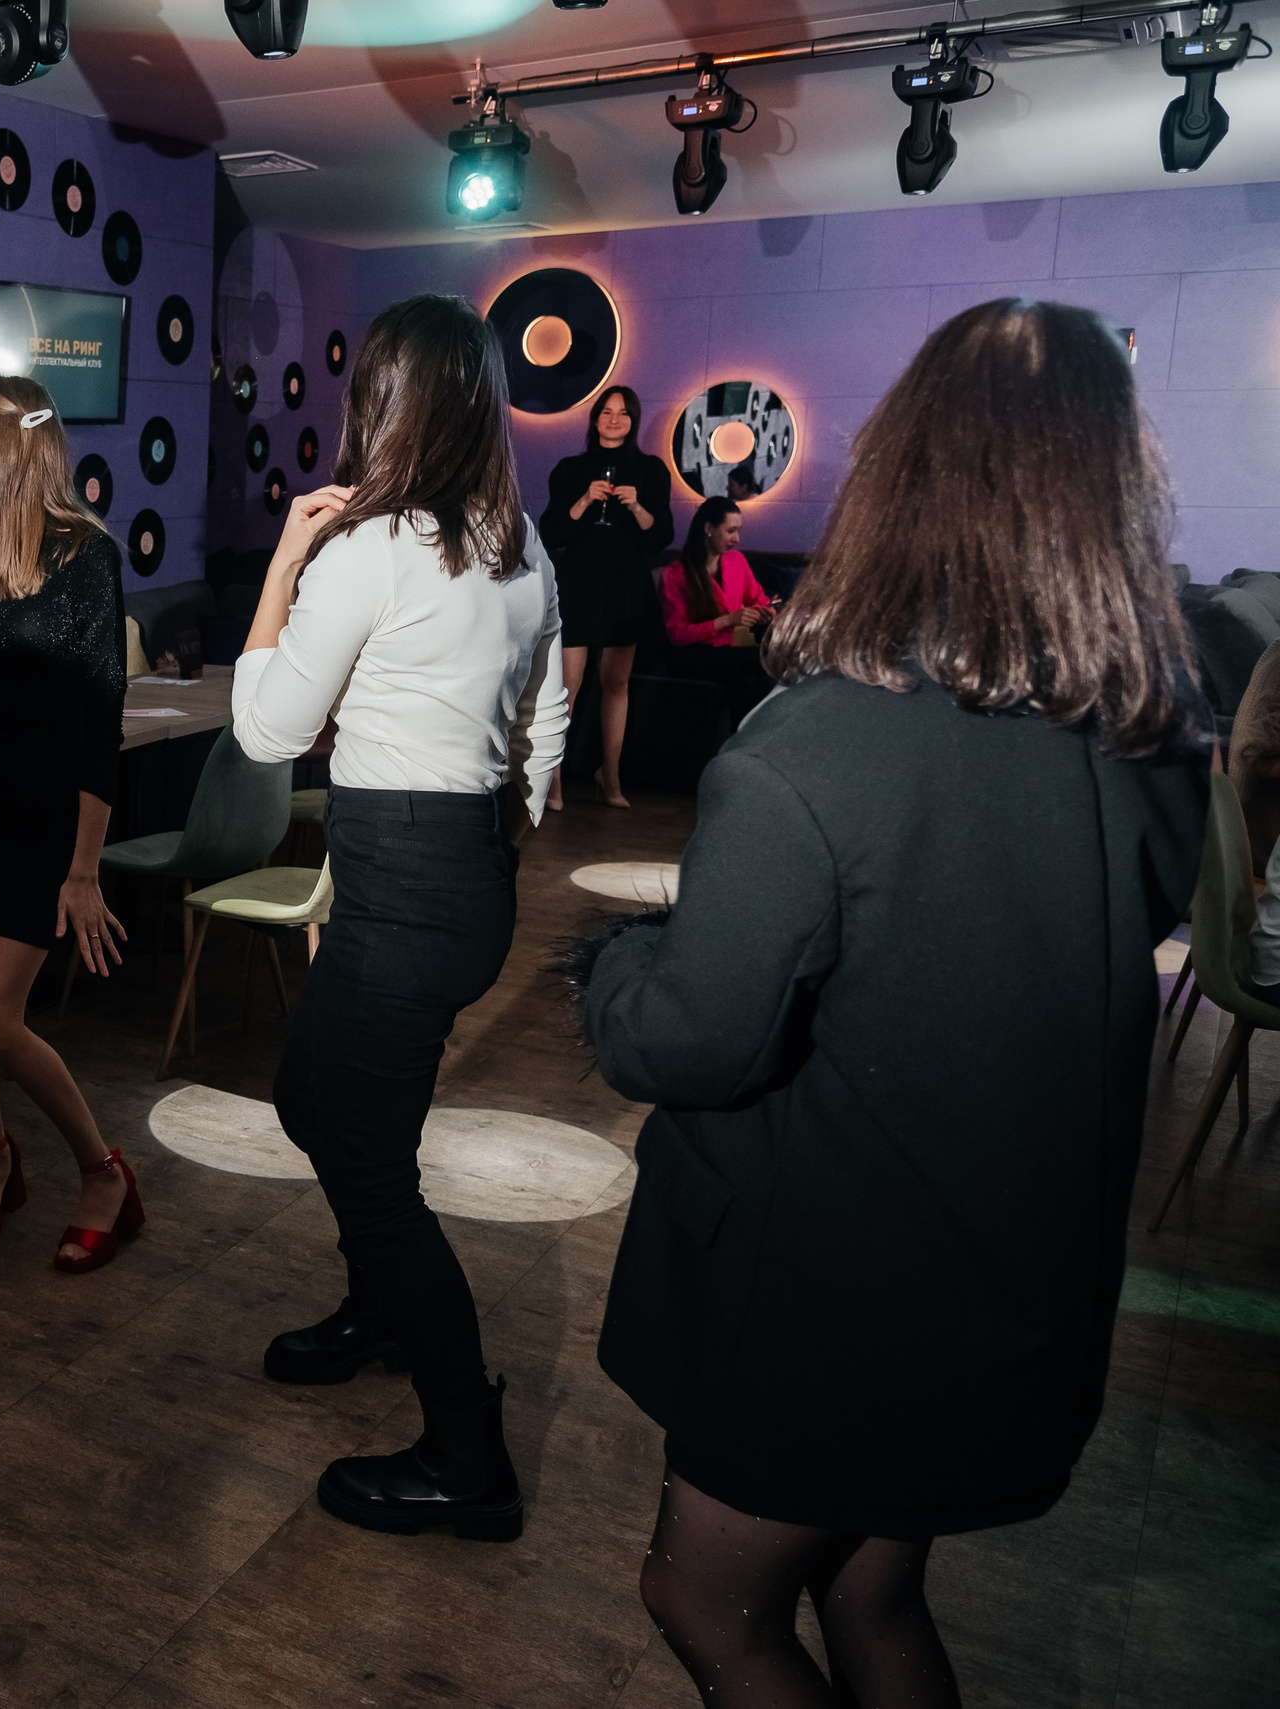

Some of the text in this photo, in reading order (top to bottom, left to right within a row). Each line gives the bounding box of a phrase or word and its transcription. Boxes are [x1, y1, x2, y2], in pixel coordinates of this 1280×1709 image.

[29, 337, 103, 356] ВСЕ НА РИНГ
[88, 359, 102, 369] КЛУБ
